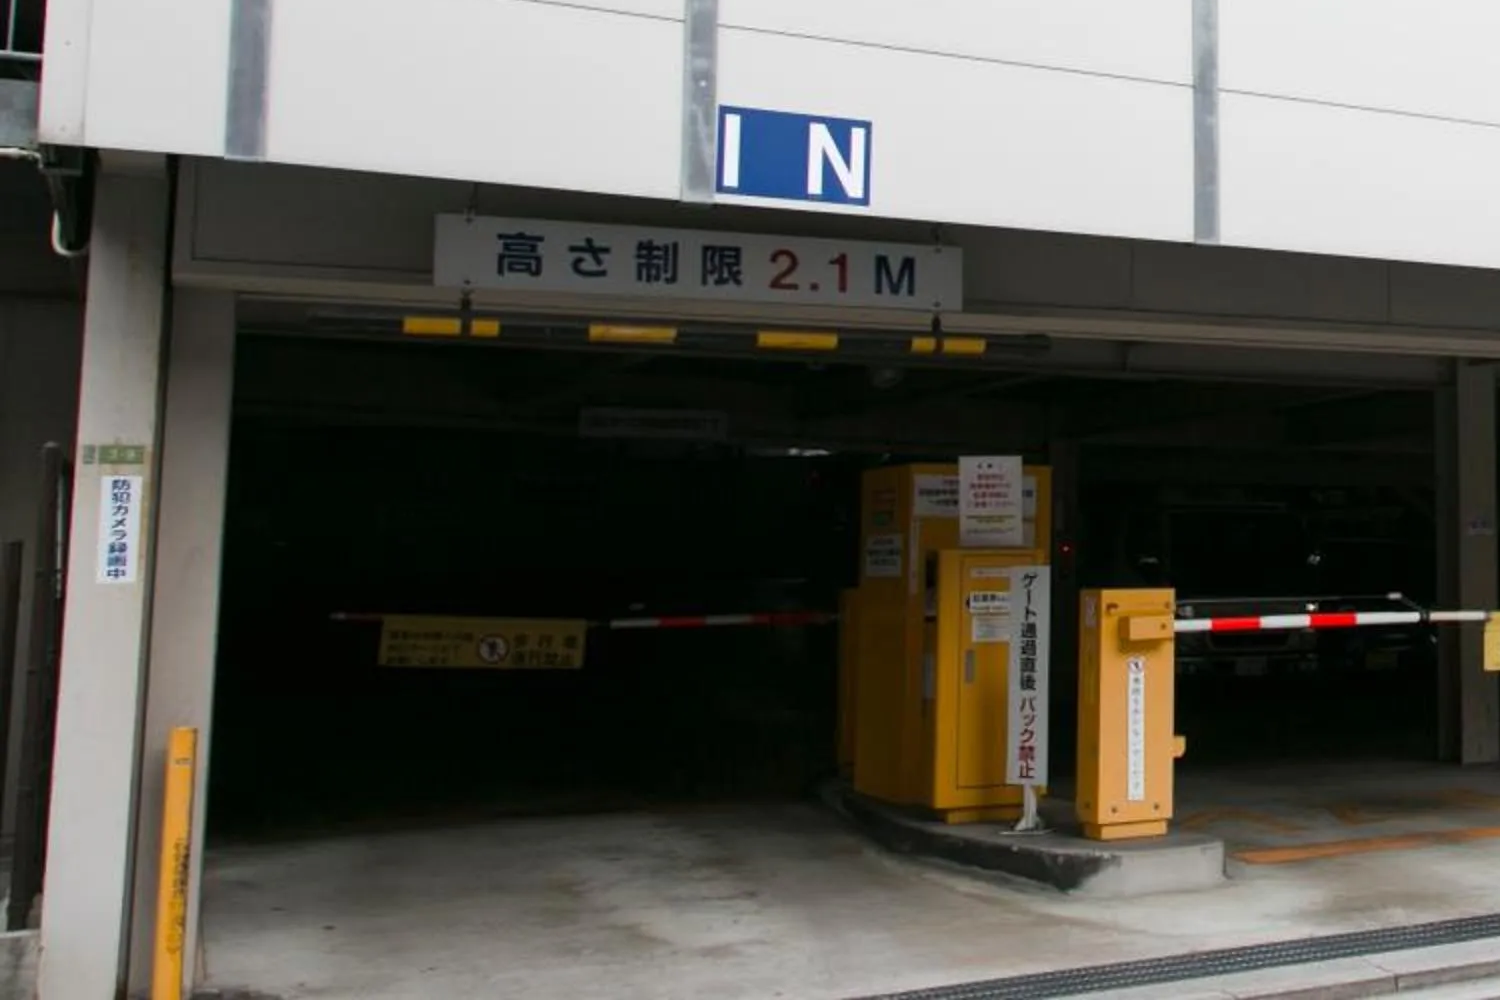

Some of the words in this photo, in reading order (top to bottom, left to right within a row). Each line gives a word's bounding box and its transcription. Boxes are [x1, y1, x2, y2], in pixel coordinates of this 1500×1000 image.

[723, 113, 866, 199] IN
[106, 478, 132, 579] 防犯カメラ録画中
